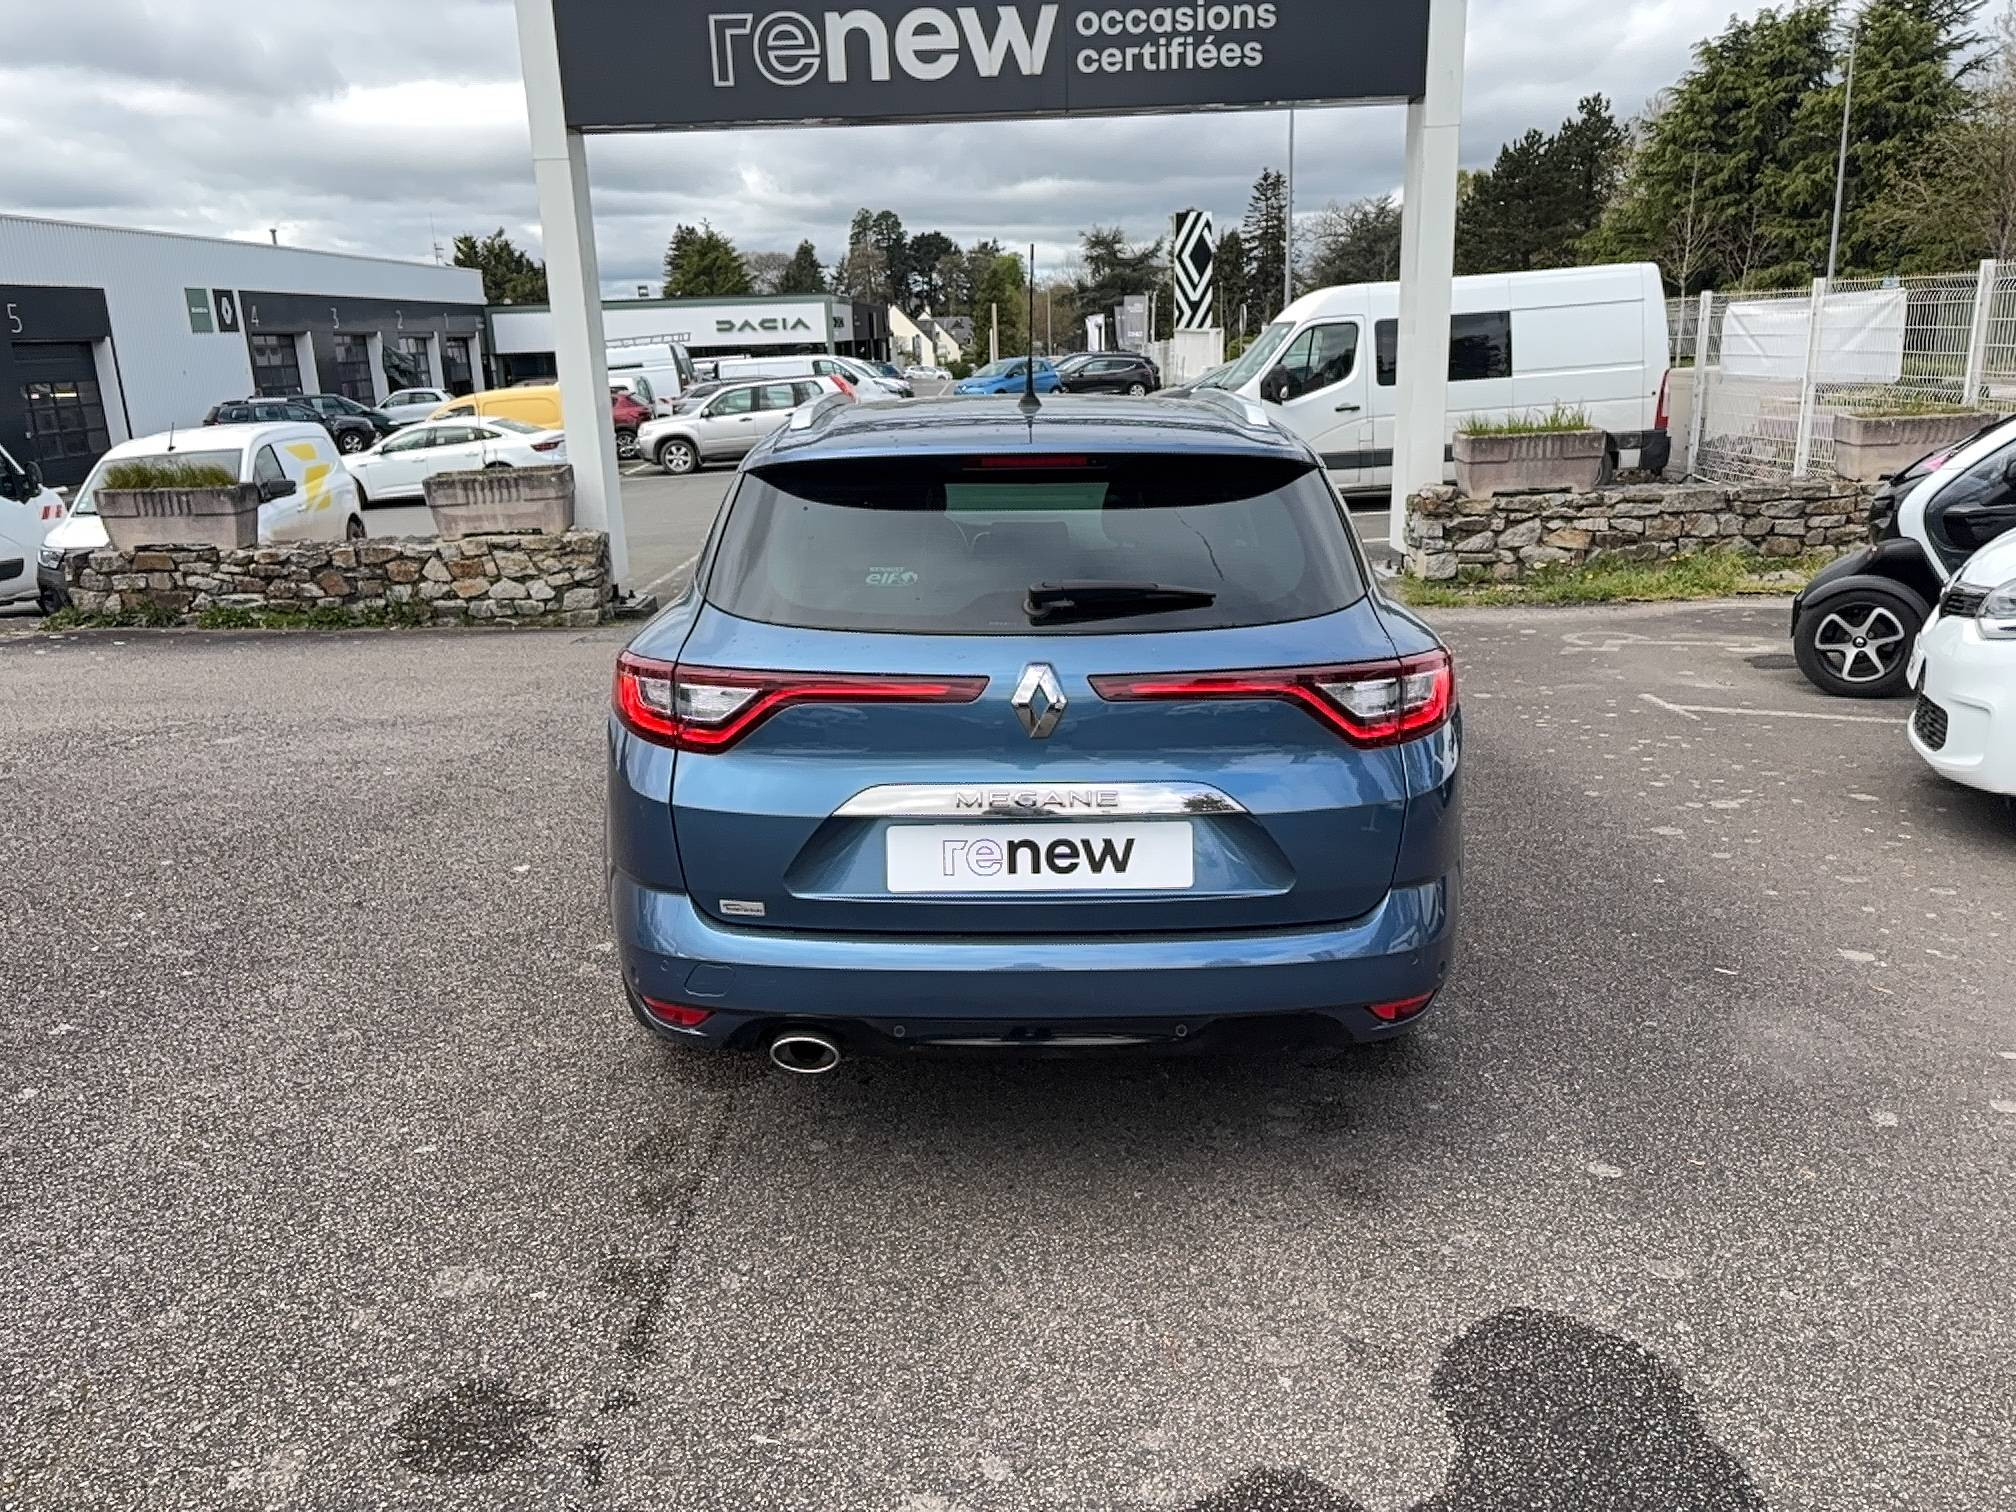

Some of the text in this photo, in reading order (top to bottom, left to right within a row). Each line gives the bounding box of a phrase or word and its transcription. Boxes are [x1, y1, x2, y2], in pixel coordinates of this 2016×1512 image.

[1075, 0, 1277, 36] occasions
[708, 4, 1059, 87] renew
[1076, 35, 1263, 73] certifiées
[7, 303, 23, 334] 5
[251, 305, 259, 327] 4
[330, 307, 340, 329] 3
[395, 309, 403, 329] 2
[715, 317, 811, 333] DACIA
[955, 791, 1119, 808] MEGANE
[942, 838, 1136, 876] renew
